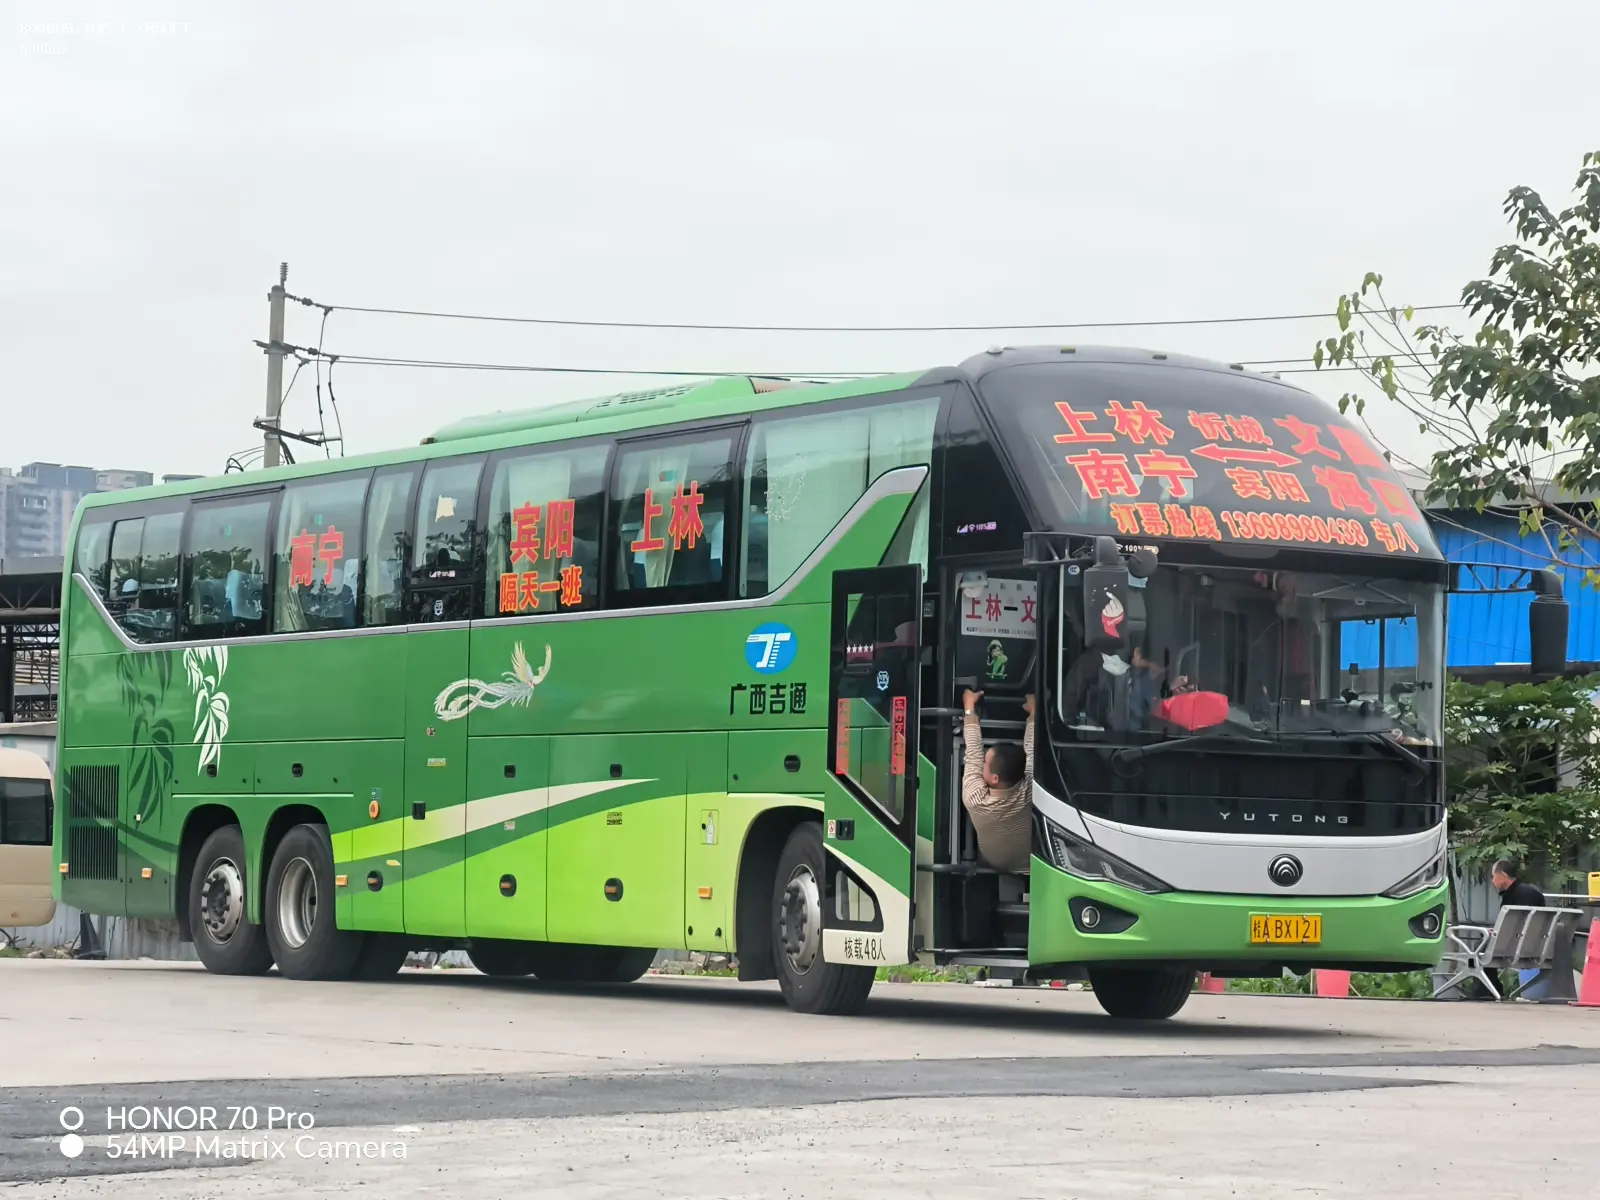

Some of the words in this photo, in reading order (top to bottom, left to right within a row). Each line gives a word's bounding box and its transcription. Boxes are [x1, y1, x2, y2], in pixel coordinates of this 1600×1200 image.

[1053, 400, 1175, 445] 上林
[1188, 410, 1274, 446] 忻城
[1065, 449, 1198, 500] 南宁
[1224, 466, 1310, 503] 宾阳
[510, 499, 575, 564] 宾阳
[631, 480, 704, 552] 上林
[1110, 502, 1222, 541] 订票热线
[1220, 510, 1369, 547] 13698980438
[290, 524, 344, 589] 南宁
[500, 564, 582, 613] 隔天一班
[729, 682, 807, 716] 广西吉通
[1219, 811, 1348, 824] YUTONG
[844, 936, 886, 961] 核载48人
